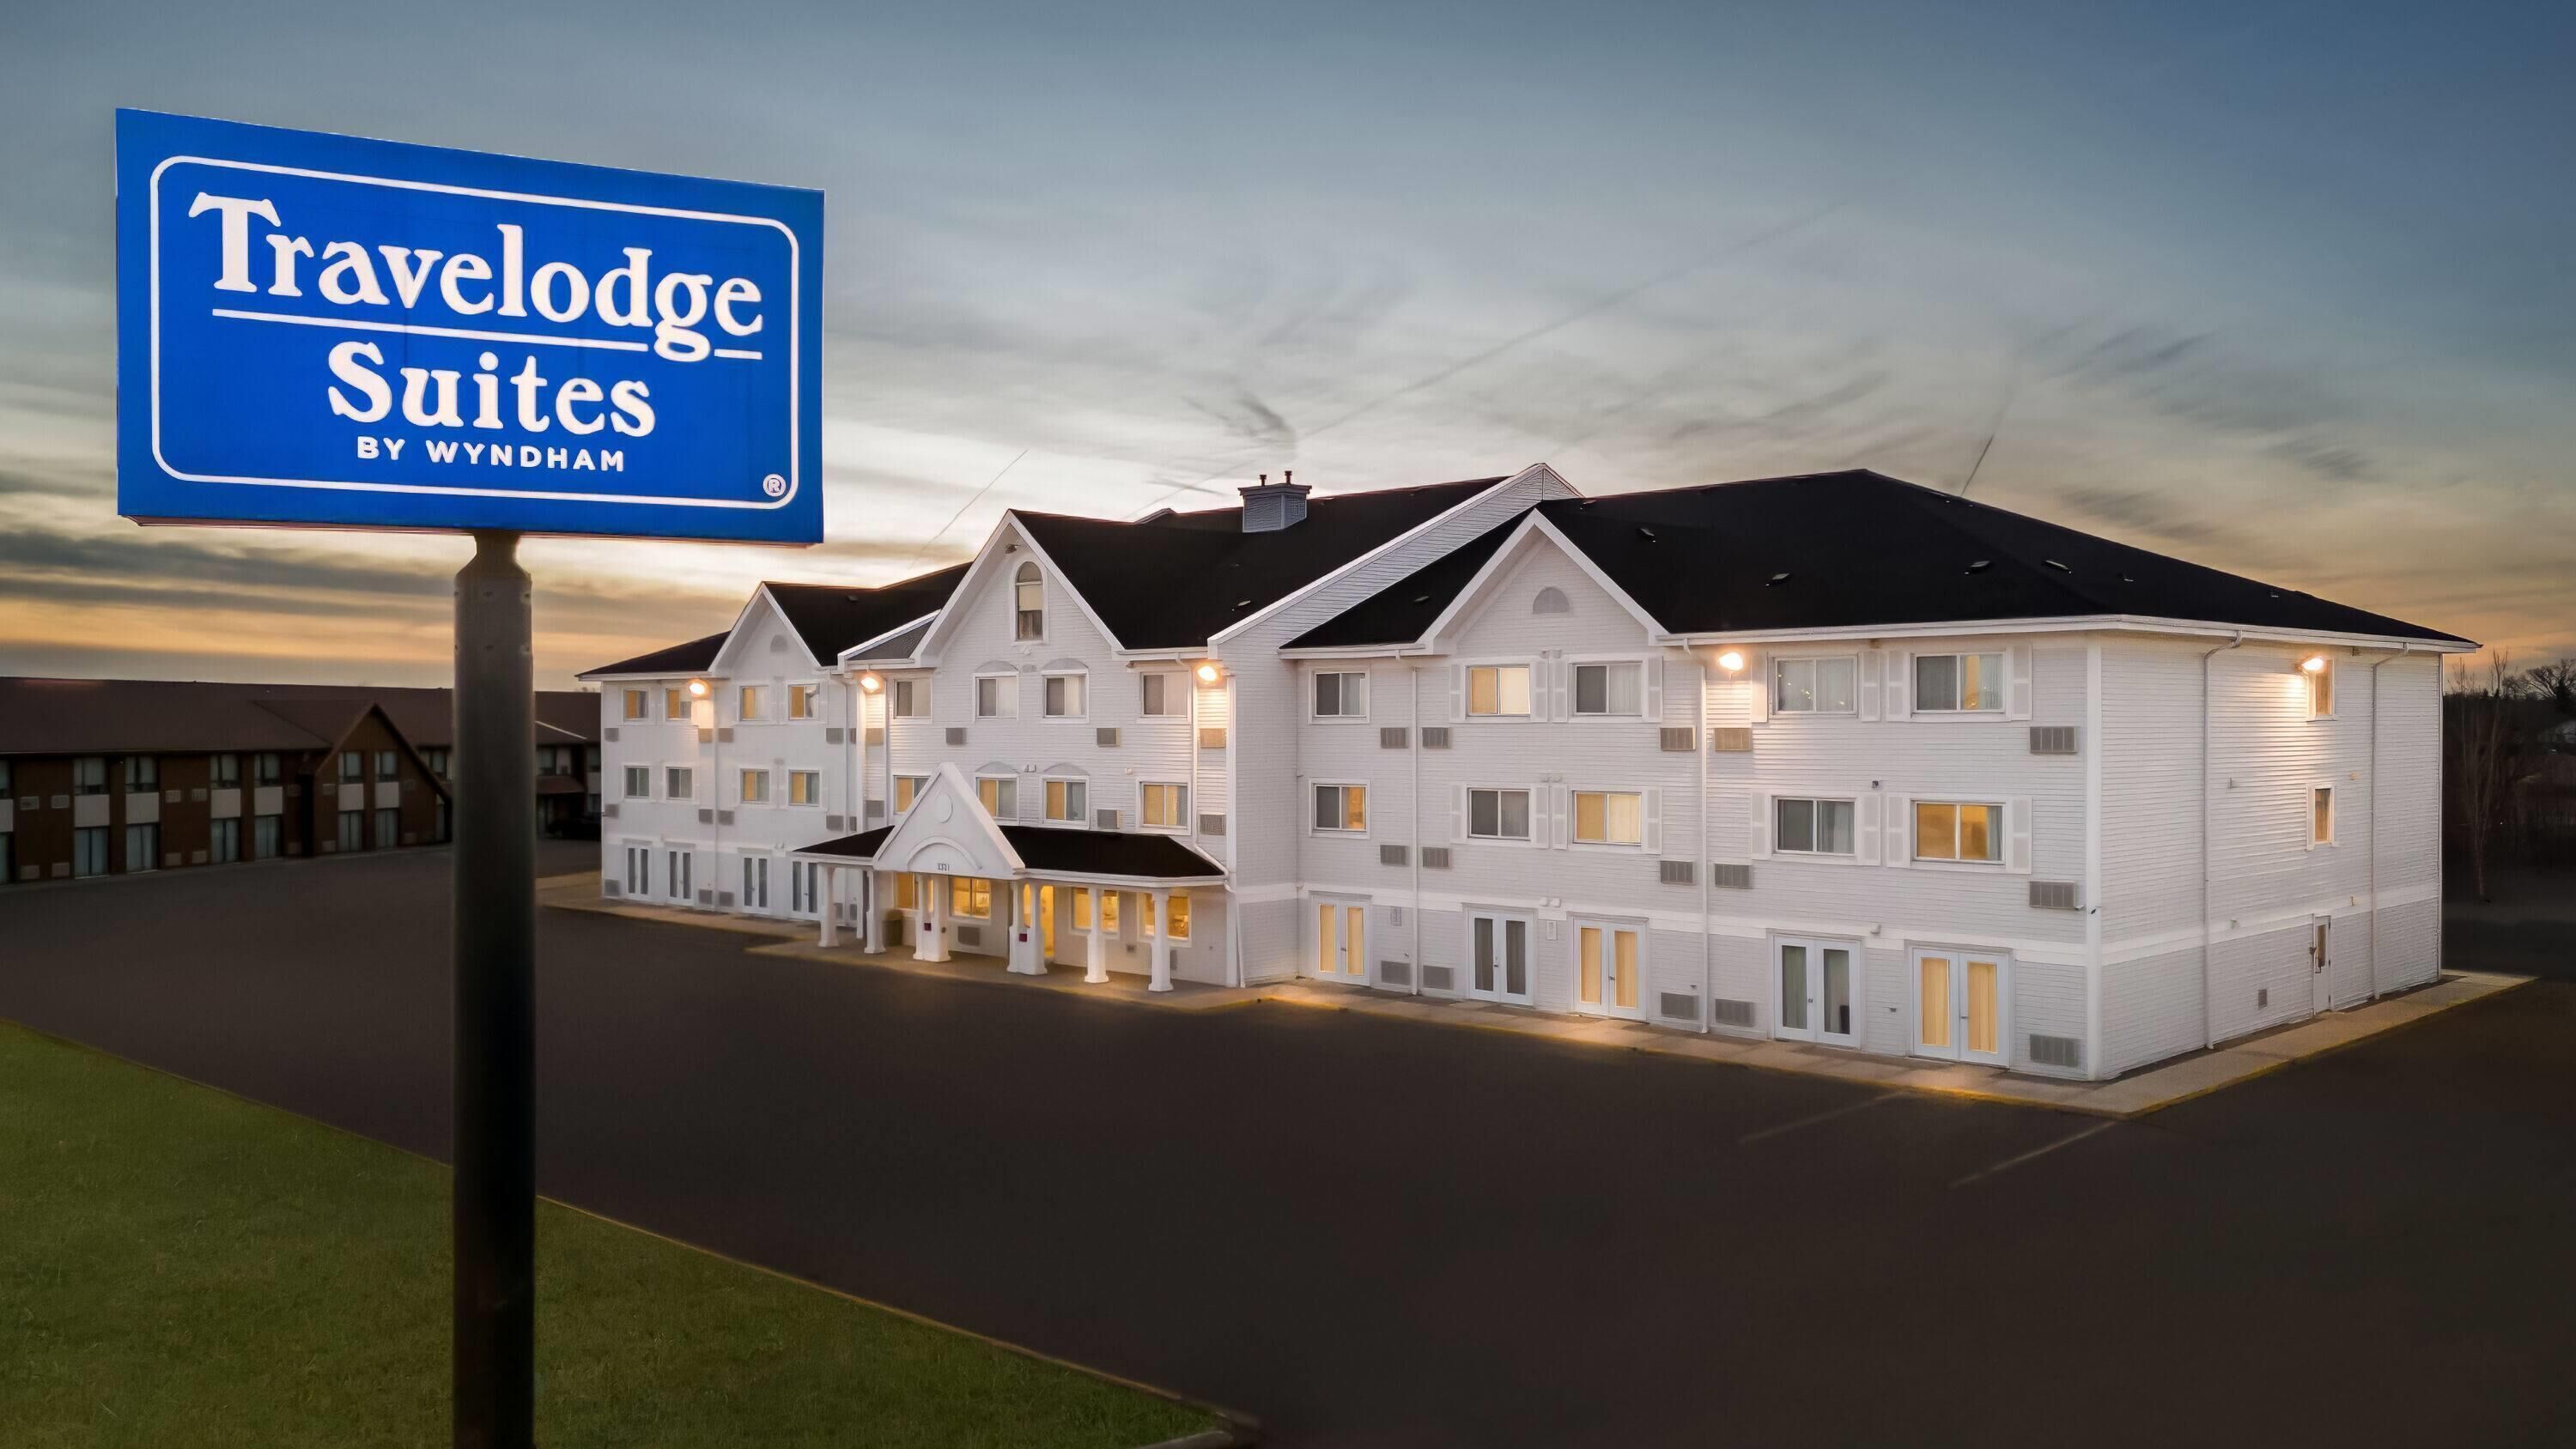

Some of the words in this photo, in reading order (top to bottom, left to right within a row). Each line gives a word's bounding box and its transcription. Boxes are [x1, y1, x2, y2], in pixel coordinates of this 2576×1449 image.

[188, 191, 762, 362] Travelodge
[328, 341, 655, 437] Suites
[357, 436, 405, 460] BY
[425, 440, 623, 472] WYNDHAM
